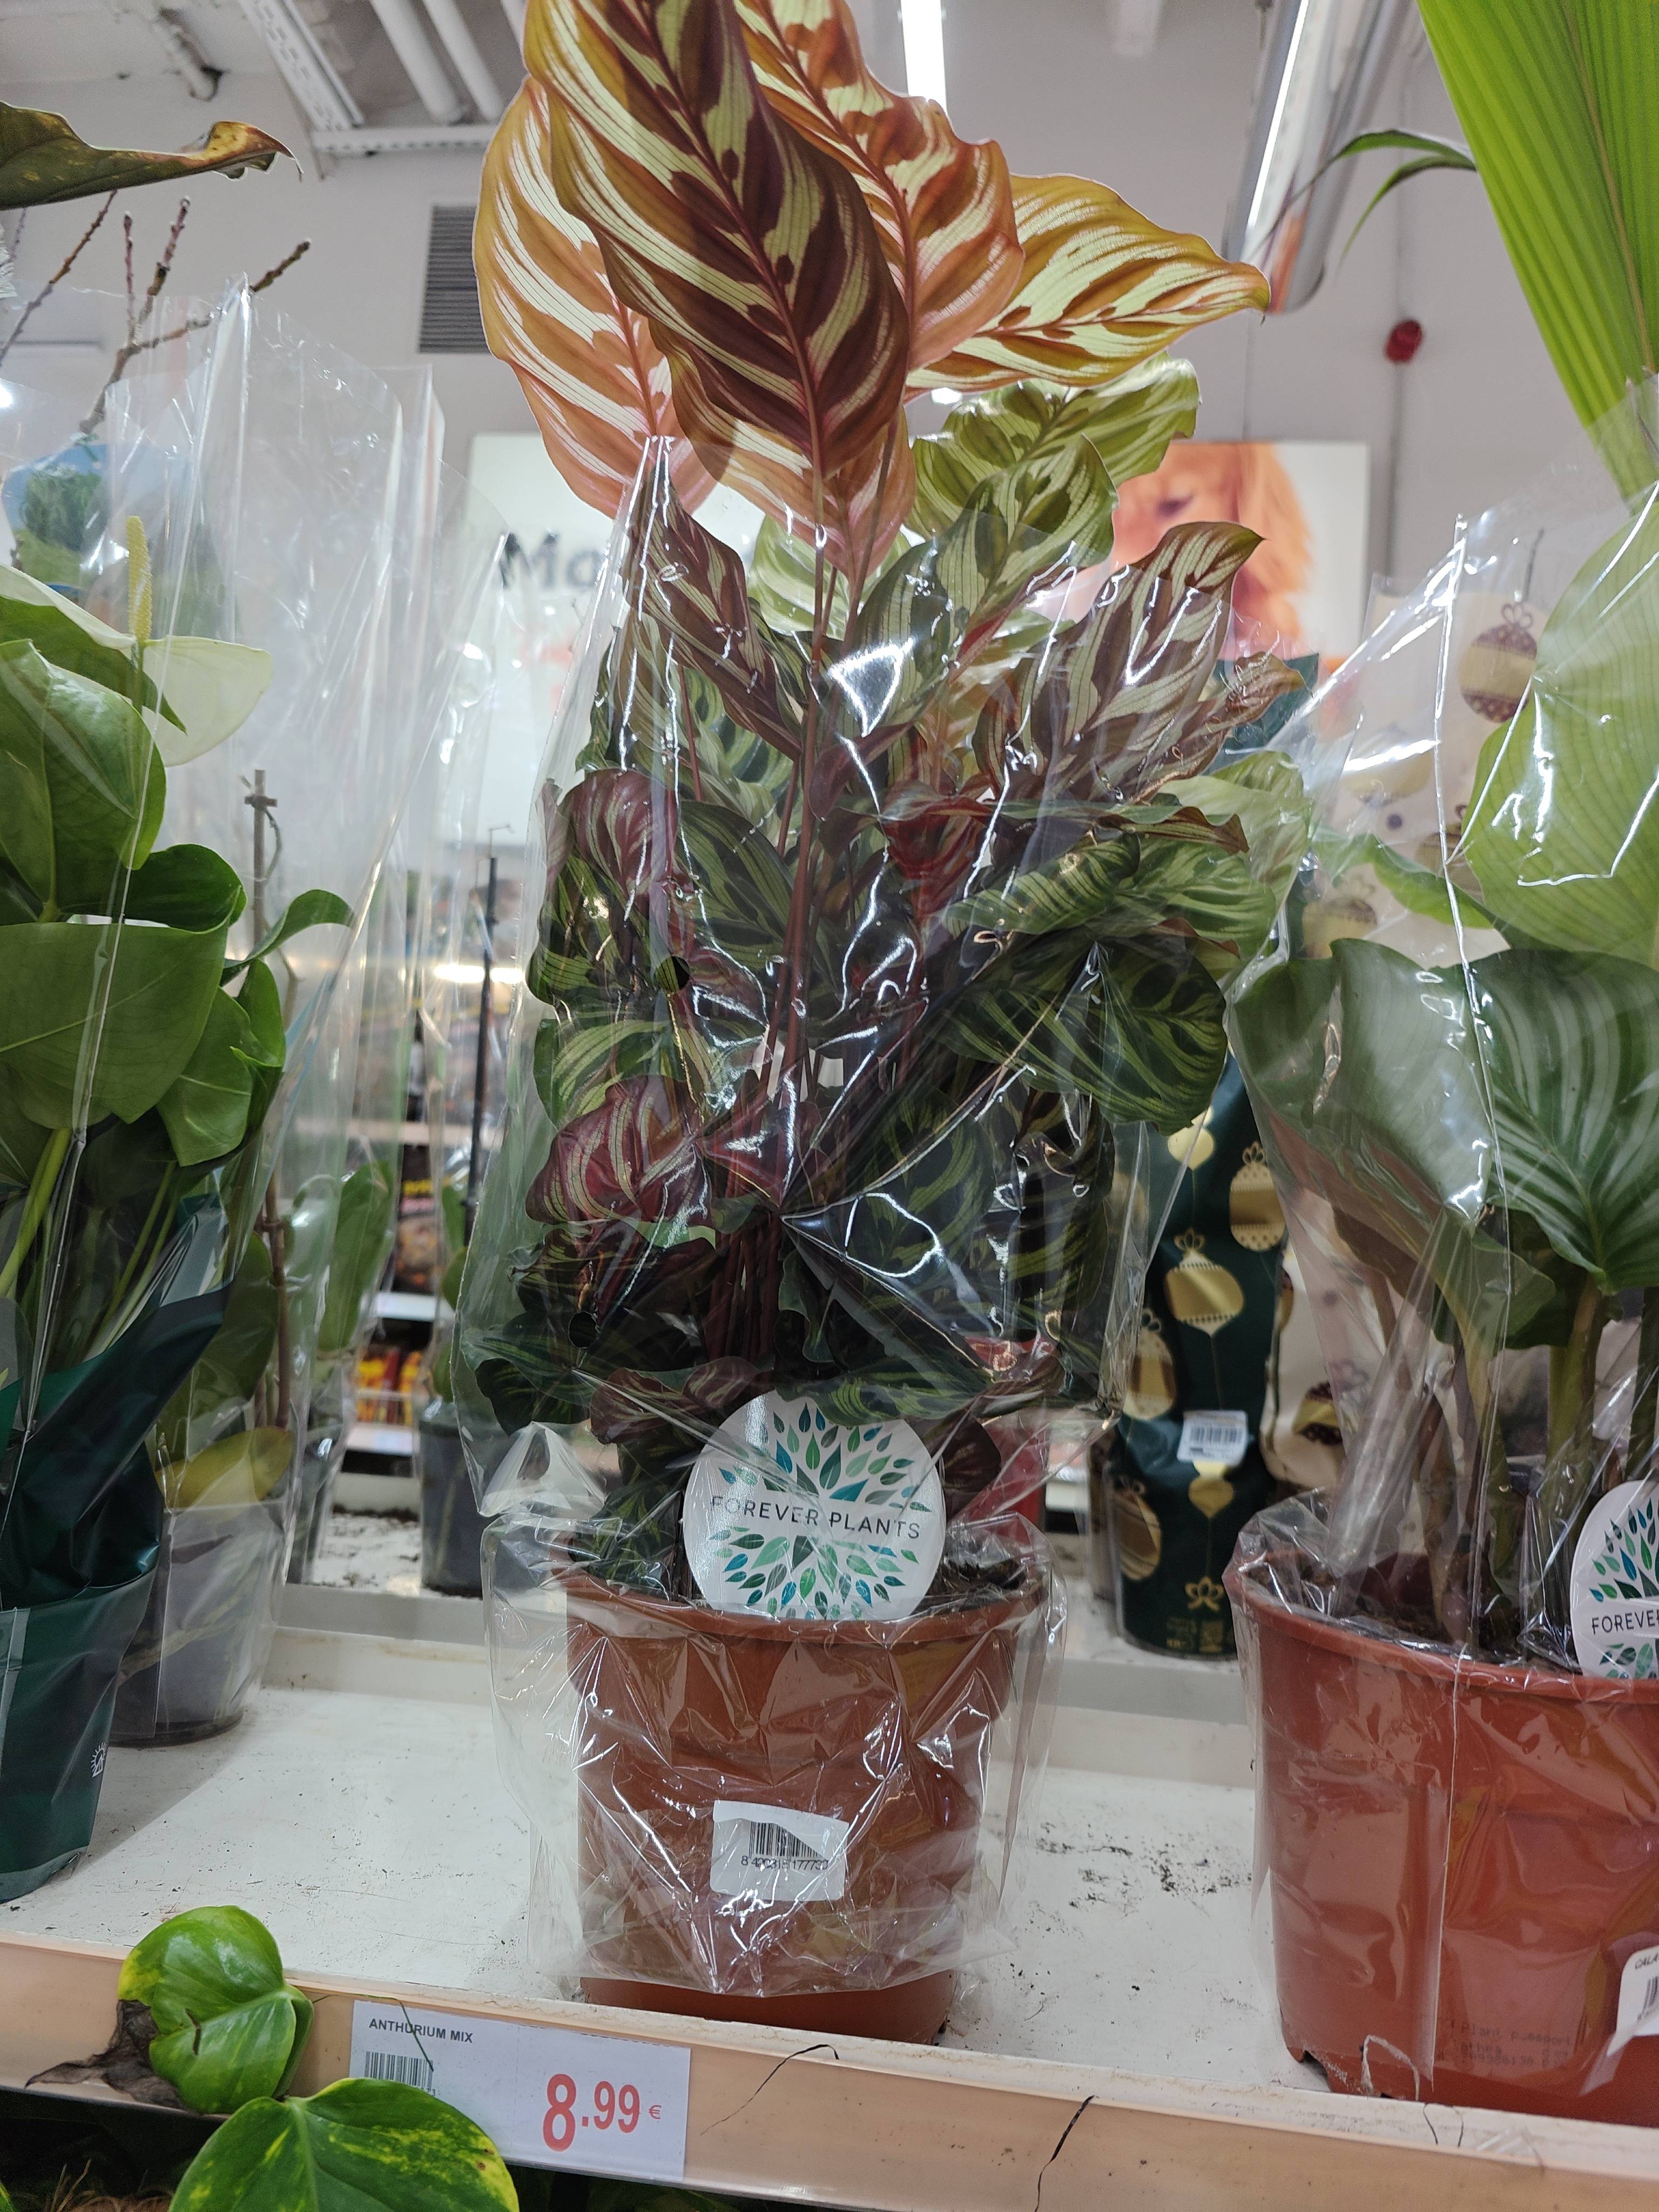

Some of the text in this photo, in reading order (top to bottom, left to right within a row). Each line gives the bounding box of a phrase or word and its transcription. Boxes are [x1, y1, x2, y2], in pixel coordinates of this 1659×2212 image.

[711, 1495, 920, 1539] FOREVER PLANTS
[1591, 1609, 1659, 1635] FOREVE
[741, 1855, 748, 1866] 8
[369, 2018, 474, 2044] ANTHURIUM MIX
[543, 2074, 640, 2152] 8.99
